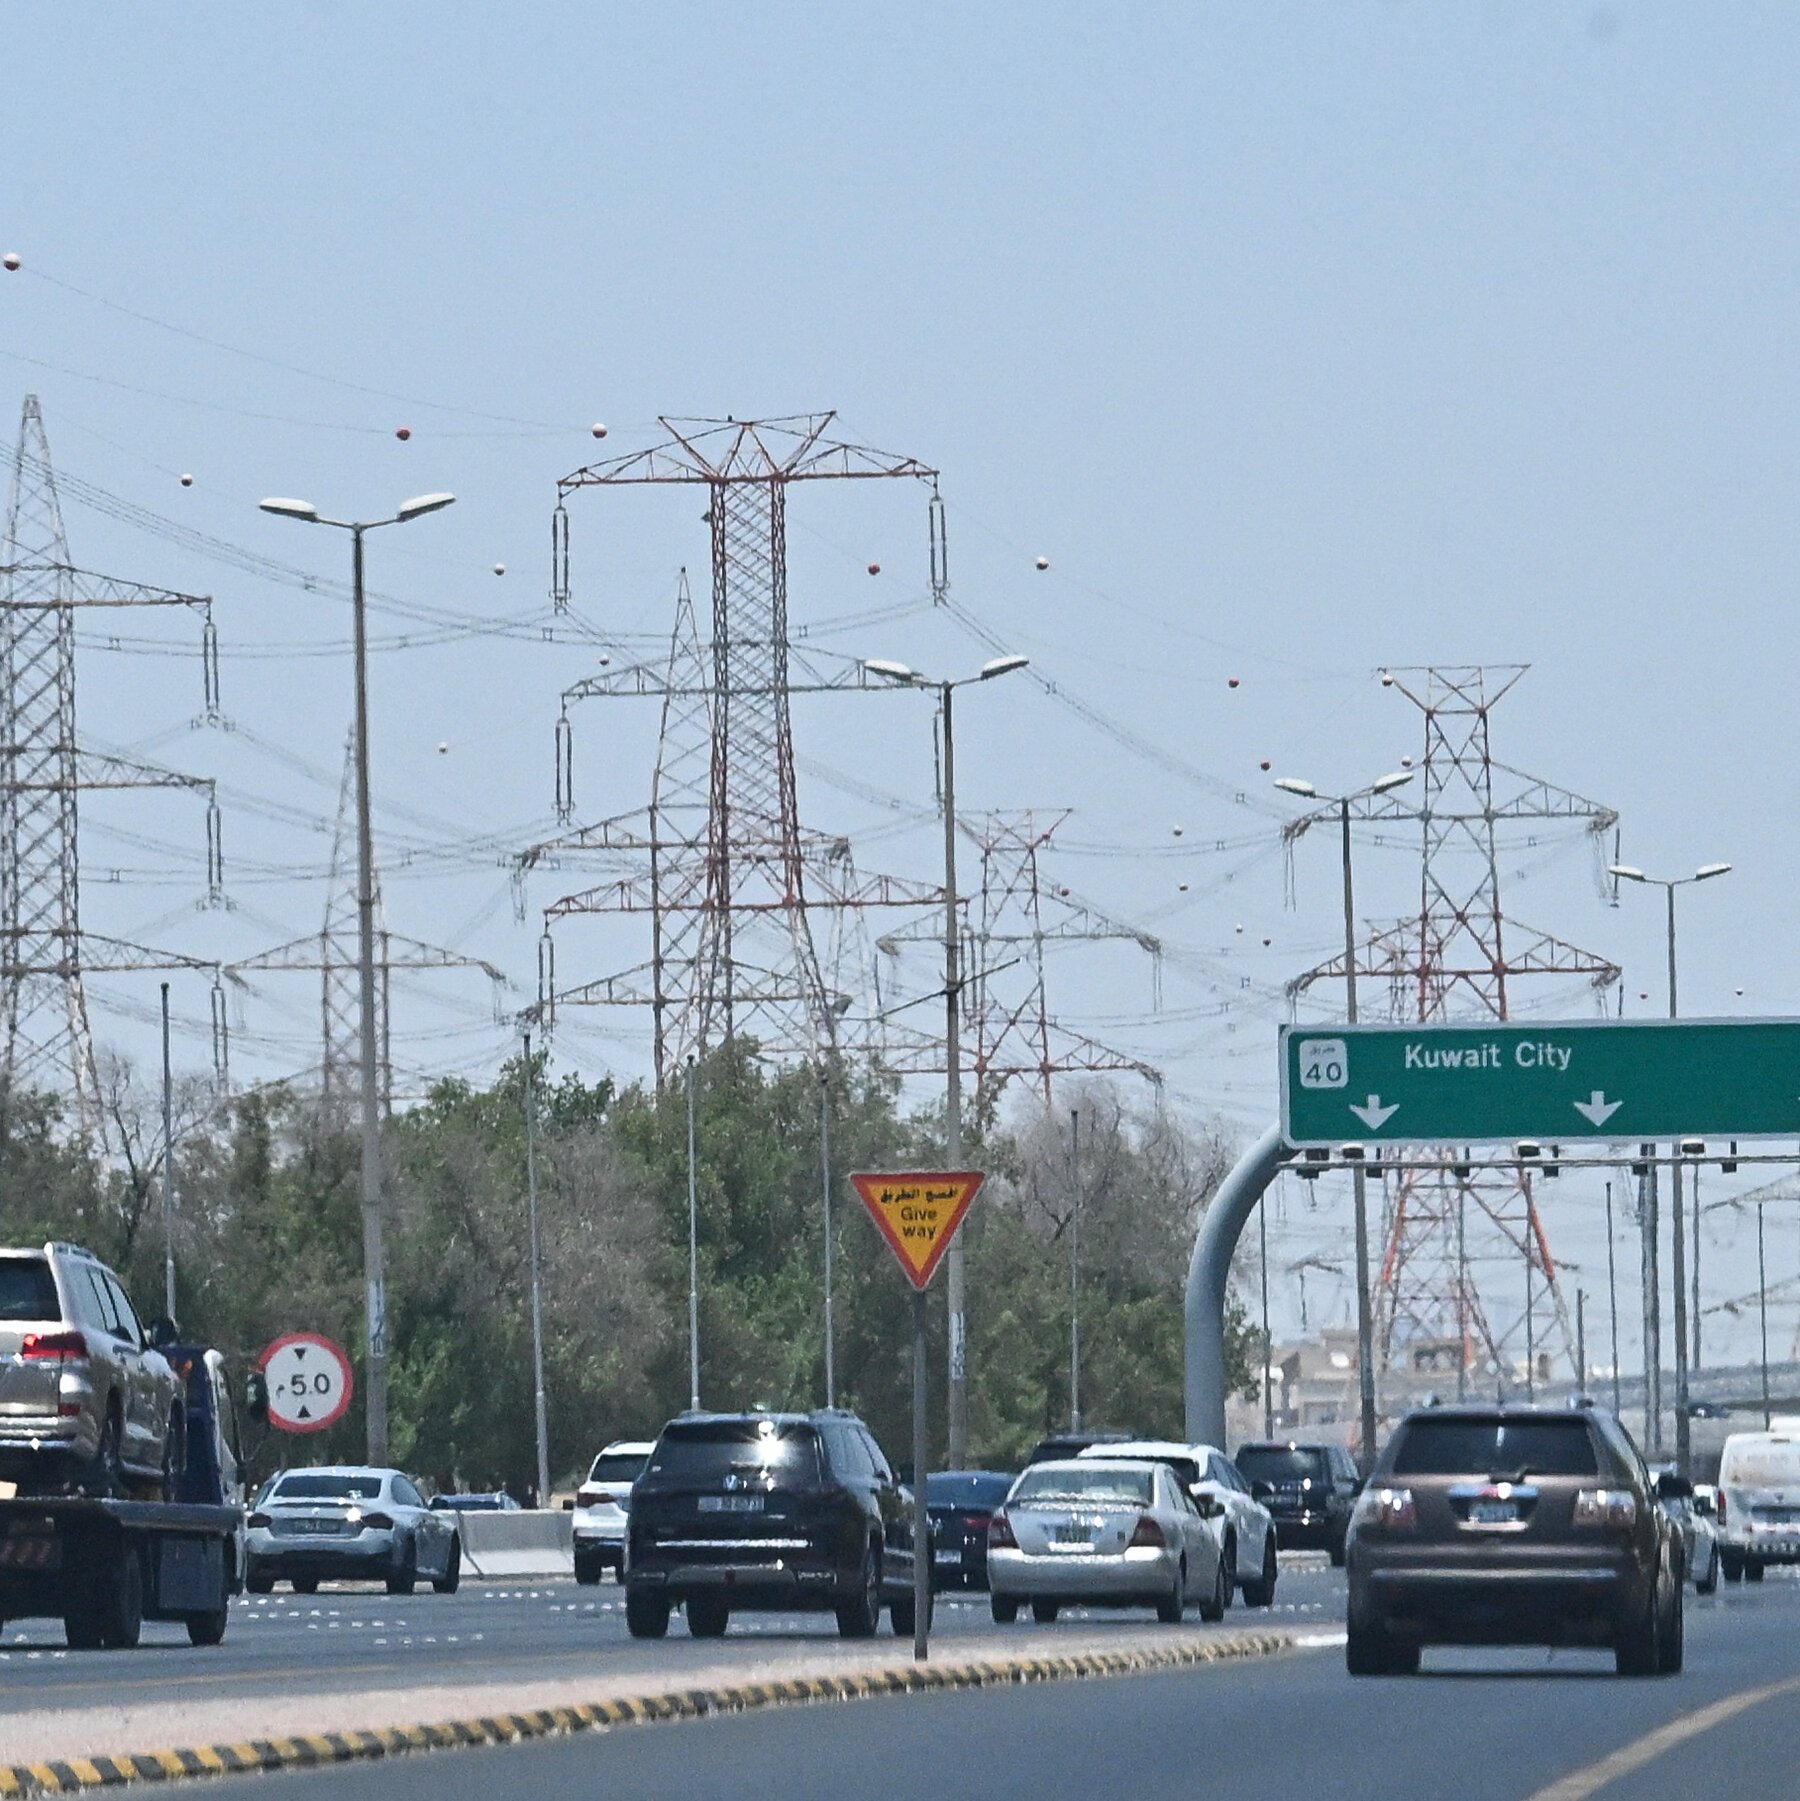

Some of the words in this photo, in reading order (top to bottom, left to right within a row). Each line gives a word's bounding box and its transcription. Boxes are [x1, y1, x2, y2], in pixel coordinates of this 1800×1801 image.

[1404, 1043, 1501, 1069] Kuwait
[1515, 1041, 1572, 1071] City
[1305, 1062, 1342, 1083] 40
[901, 1207, 938, 1221] Give
[903, 1226, 936, 1240] way
[291, 1373, 330, 1396] 5.0
